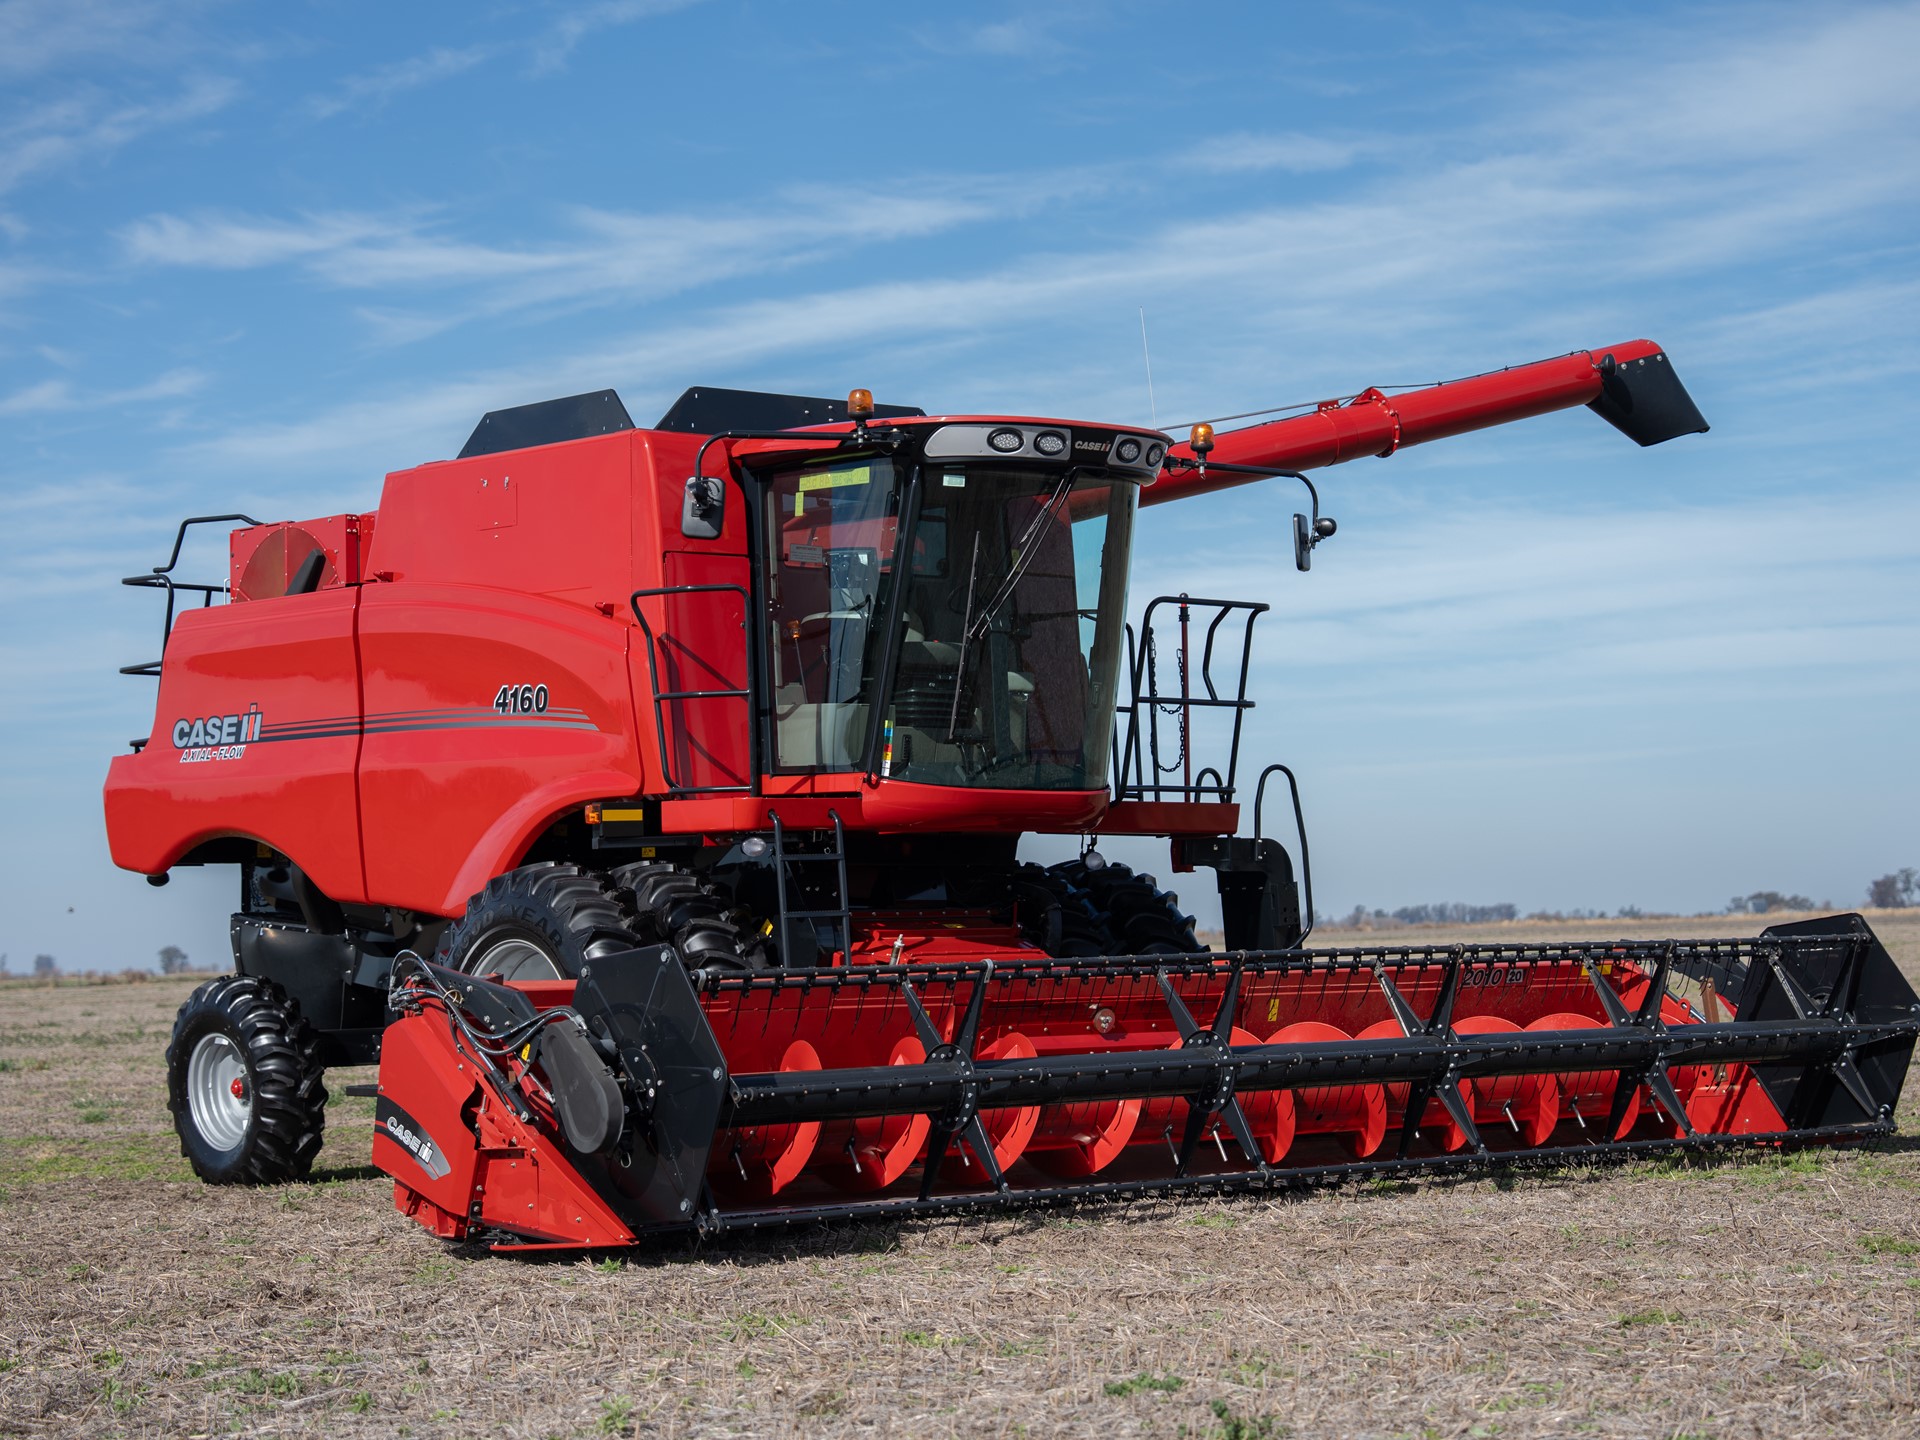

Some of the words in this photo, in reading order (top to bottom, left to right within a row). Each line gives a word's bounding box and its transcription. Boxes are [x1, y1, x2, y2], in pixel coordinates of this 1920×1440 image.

[1075, 441, 1100, 451] CASE
[493, 683, 549, 715] 4160
[172, 714, 239, 749] CASE
[180, 745, 246, 763] AXIAL-FLOW
[1462, 968, 1503, 987] 2010
[1508, 969, 1523, 983] 20
[386, 1116, 422, 1153] CASE
